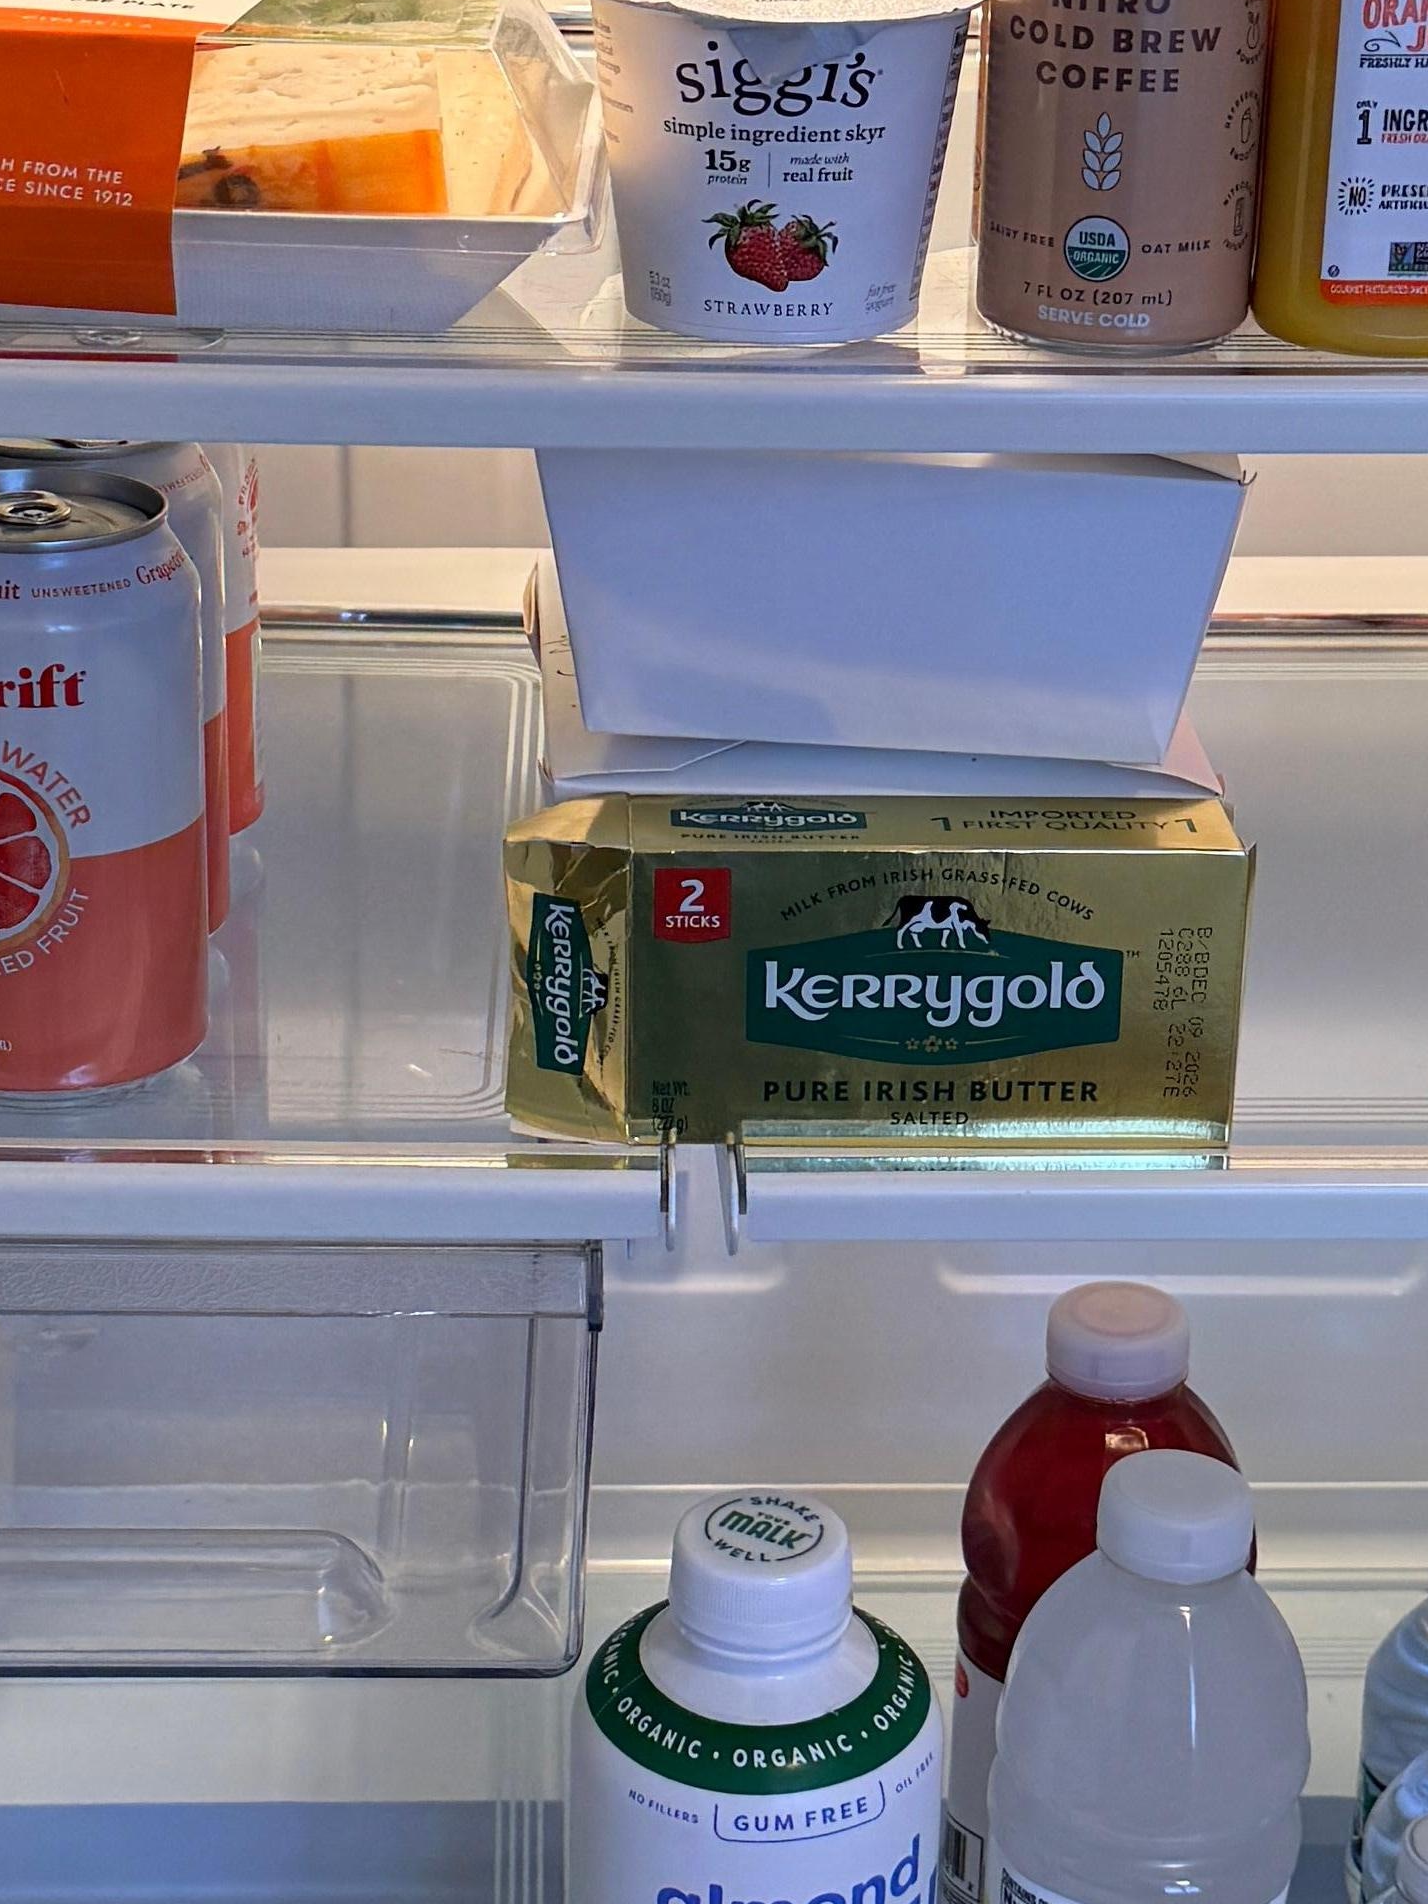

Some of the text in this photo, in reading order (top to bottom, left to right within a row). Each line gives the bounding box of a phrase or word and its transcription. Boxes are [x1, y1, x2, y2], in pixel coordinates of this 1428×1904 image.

[1010, 15, 1222, 54] COLD BREW
[675, 40, 877, 117] siggi's
[1036, 60, 1180, 93] COFFEE
[663, 116, 887, 145] simple ingredient skyr
[22, 159, 79, 179] FROM
[87, 167, 123, 185] THE
[782, 167, 854, 183] real fruit
[24, 181, 84, 201] SINCE
[93, 189, 133, 207] 1912
[1349, 185, 1367, 207] NO
[1078, 231, 1116, 248] USDA
[703, 298, 834, 318] STRAWBERRY
[1093, 289, 1133, 306] (207
[1037, 305, 1094, 327] SERVE
[31, 577, 132, 599] UNSWEETENED
[1, 739, 92, 829] WATER
[679, 811, 858, 827] Kerrygold
[962, 819, 1168, 833] FIRST QUALITY
[988, 809, 1137, 820] IMPORTED
[679, 879, 705, 913] 2
[780, 867, 1095, 921] MILK FROM IRISH GRASS-FED COWS
[36, 887, 91, 955] FRUIT
[665, 915, 720, 929] STICKS
[544, 902, 580, 1067] Kerrygold
[764, 959, 1105, 1028] Kerrygold
[764, 1080, 1098, 1102] PURE IRISH BUTTER
[890, 1111, 969, 1125] SALTED
[749, 1495, 820, 1522] SHAKE
[719, 1510, 813, 1550] MALK
[713, 1538, 772, 1563] WELL
[616, 1652, 916, 1769] ORGANIC ORGANIC ORGANIC
[628, 1788, 699, 1825] NO FILLERS
[733, 1796, 869, 1832] GUM FREE
